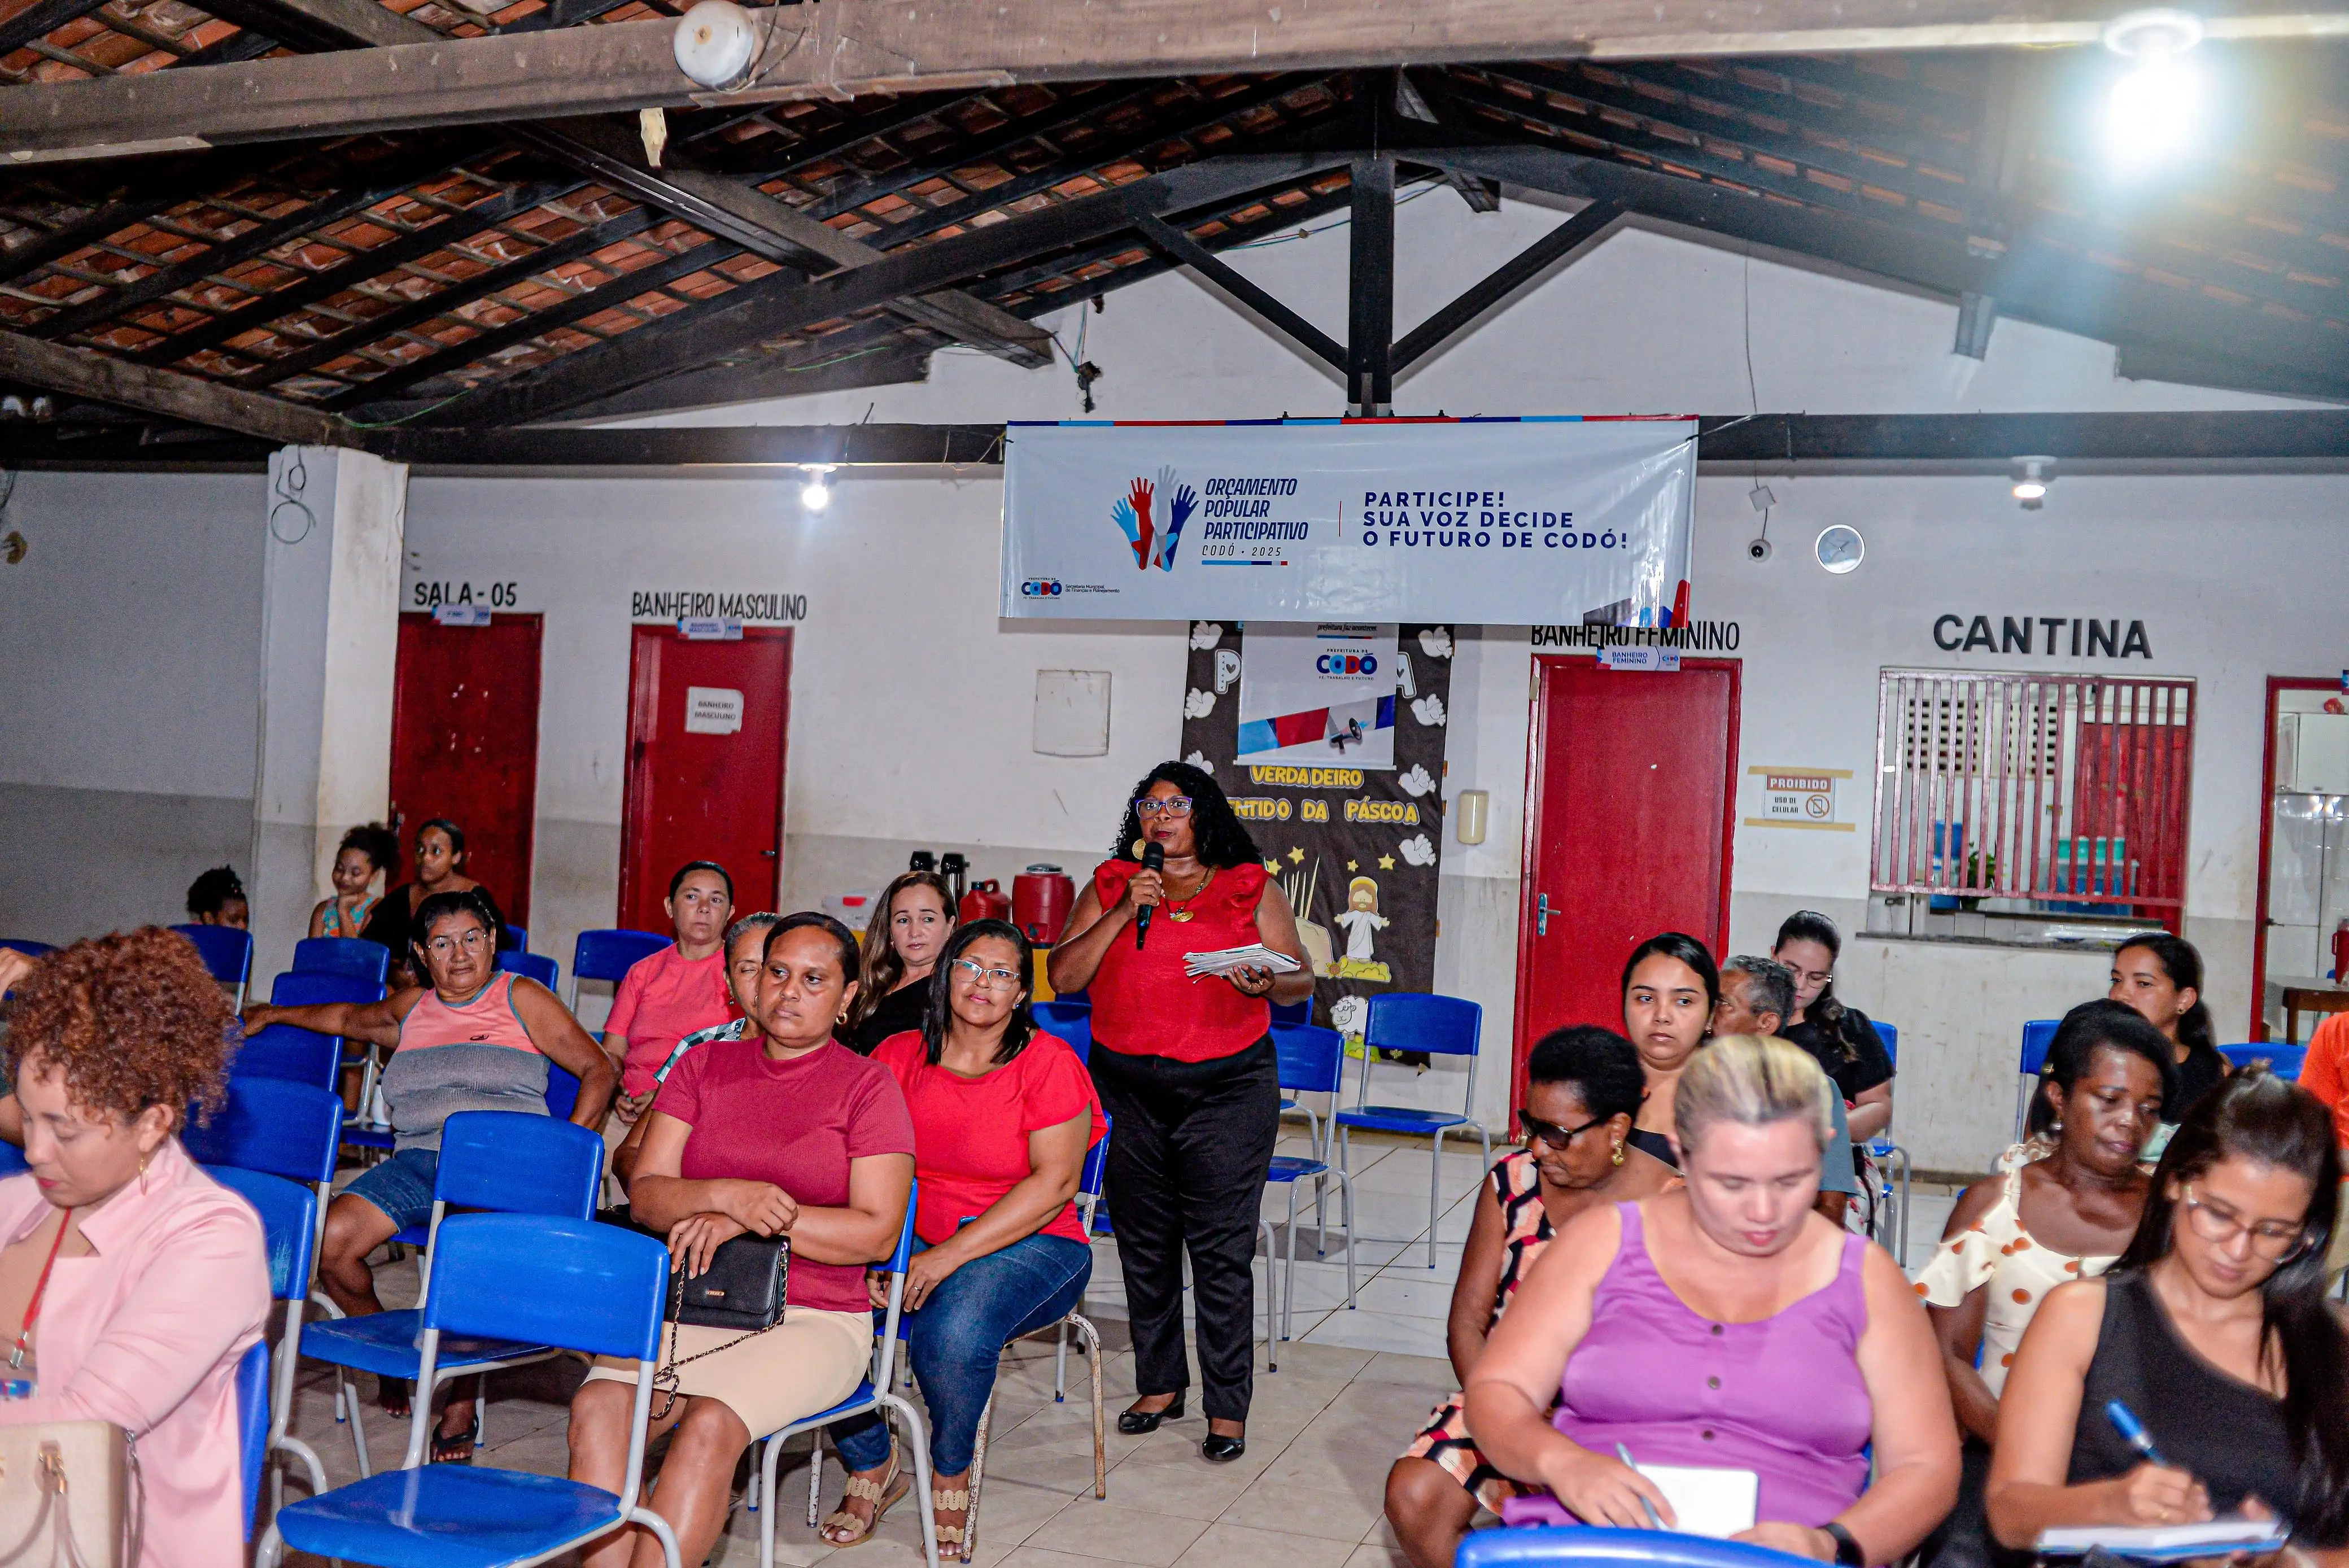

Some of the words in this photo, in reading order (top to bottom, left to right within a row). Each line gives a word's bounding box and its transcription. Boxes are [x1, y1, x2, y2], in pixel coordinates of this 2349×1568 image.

[1205, 478, 1298, 499] ORÇAMENTO
[1364, 491, 1504, 507] PARTICIPE!
[1204, 500, 1270, 517] POPULAR
[1363, 511, 1411, 527] SUA
[1420, 511, 1469, 527] VOZ
[1480, 512, 1573, 528] DECIDE
[1204, 522, 1309, 540] PARTICIPATIVO
[1363, 531, 1378, 547] O
[1390, 531, 1491, 548] FUTURO
[1502, 532, 1532, 548] DE
[1544, 529, 1627, 549] CODÓ!
[1202, 543, 1235, 556] CODÓ
[1252, 547, 1281, 556] 2025
[1021, 580, 1062, 596] CODÓ
[632, 592, 714, 618] BANHEIRO
[718, 593, 807, 621] MASCULINO
[1317, 623, 1342, 631] prefeitura
[1933, 614, 2153, 659] CANTINA
[1316, 653, 1378, 675] CODÓ
[698, 701, 734, 709] BANHEIRO
[695, 711, 736, 720] MASCULINO
[1250, 765, 1363, 787] VERDADEIRO
[1770, 778, 1828, 790] PROIBIDO
[1229, 800, 1291, 818] NTIDO
[1303, 802, 1327, 820] DA
[1346, 796, 1418, 823] PÁSCOA
